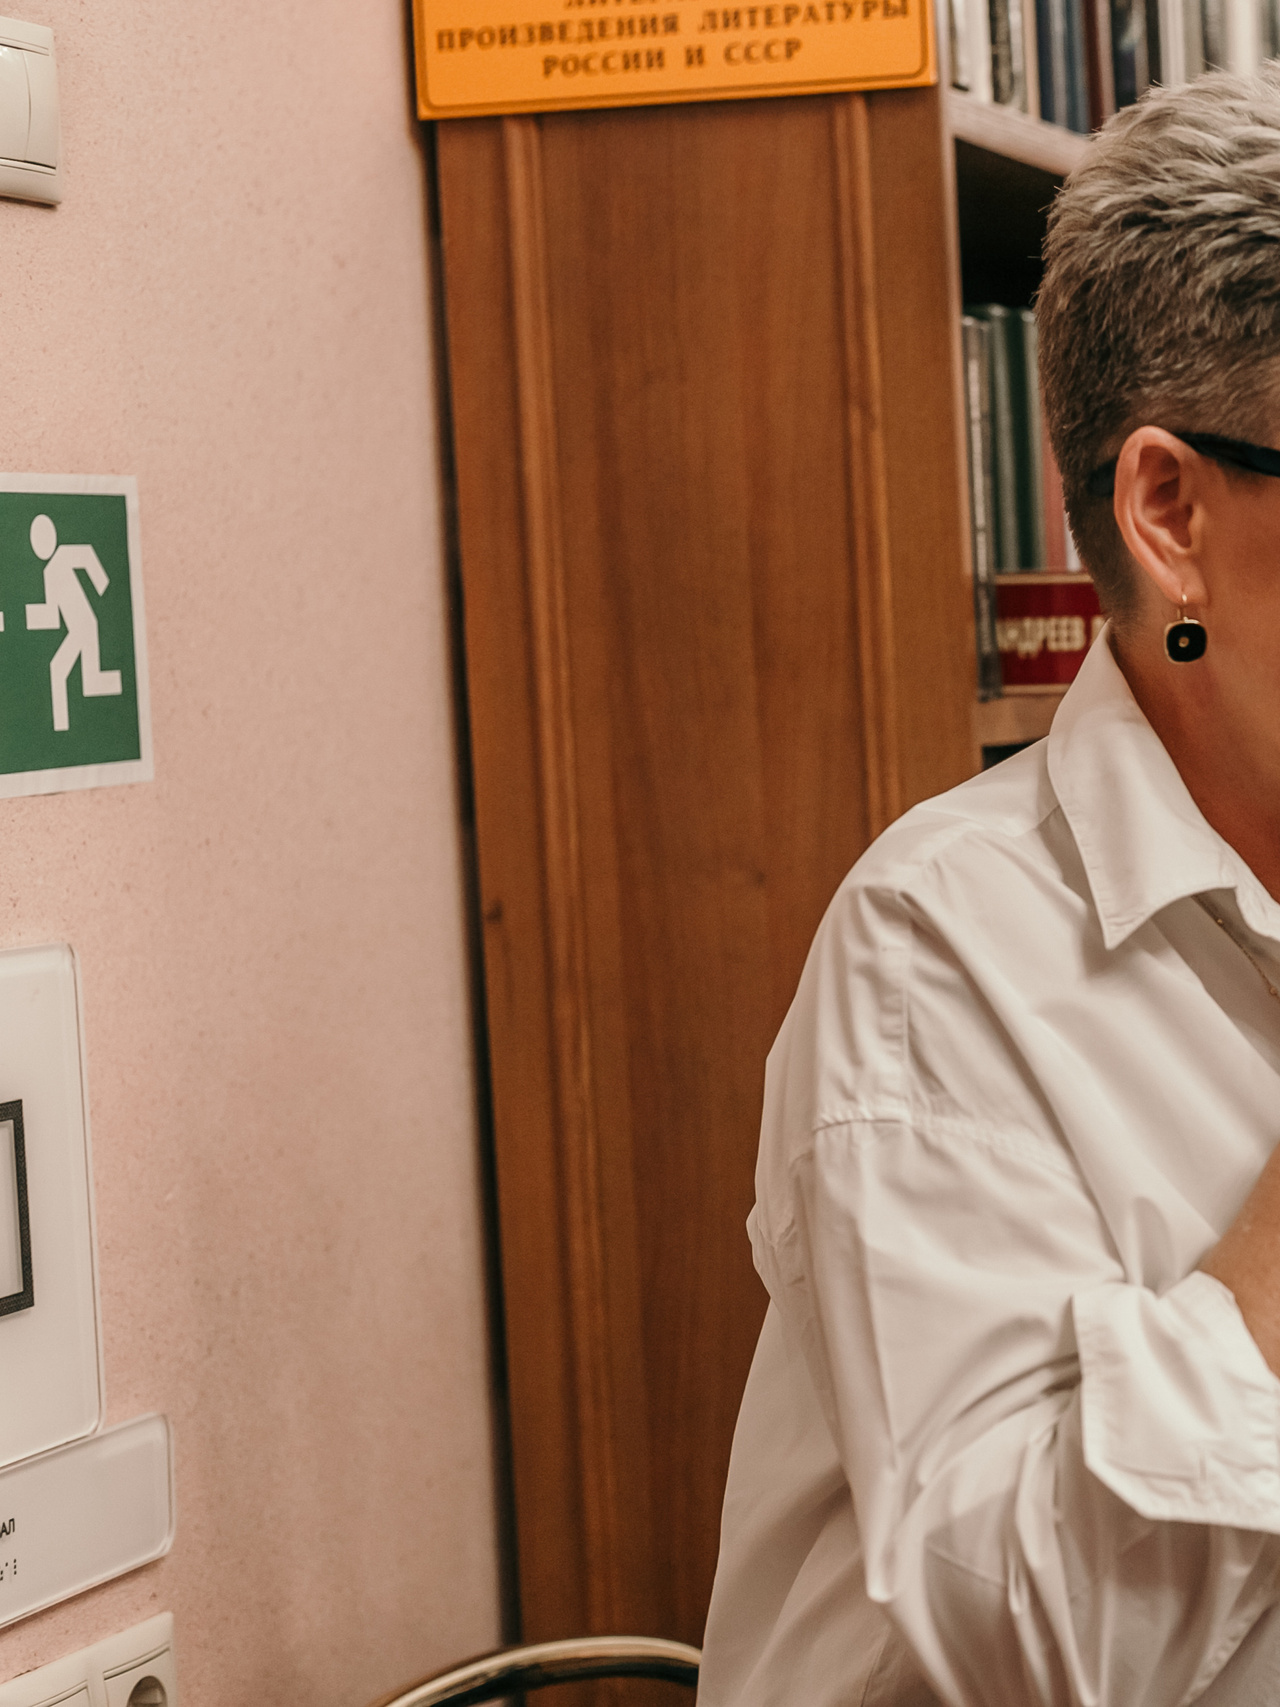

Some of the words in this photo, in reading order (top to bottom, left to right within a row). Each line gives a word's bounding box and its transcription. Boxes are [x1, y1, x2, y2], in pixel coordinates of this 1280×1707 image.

[436, 13, 678, 52] ПРОИЗВЕДЕНИЯ
[698, 0, 908, 34] ЛИТЕРАТУРЫ
[542, 48, 665, 78] РОССИИ
[685, 44, 704, 68] И
[724, 38, 802, 66] СССР
